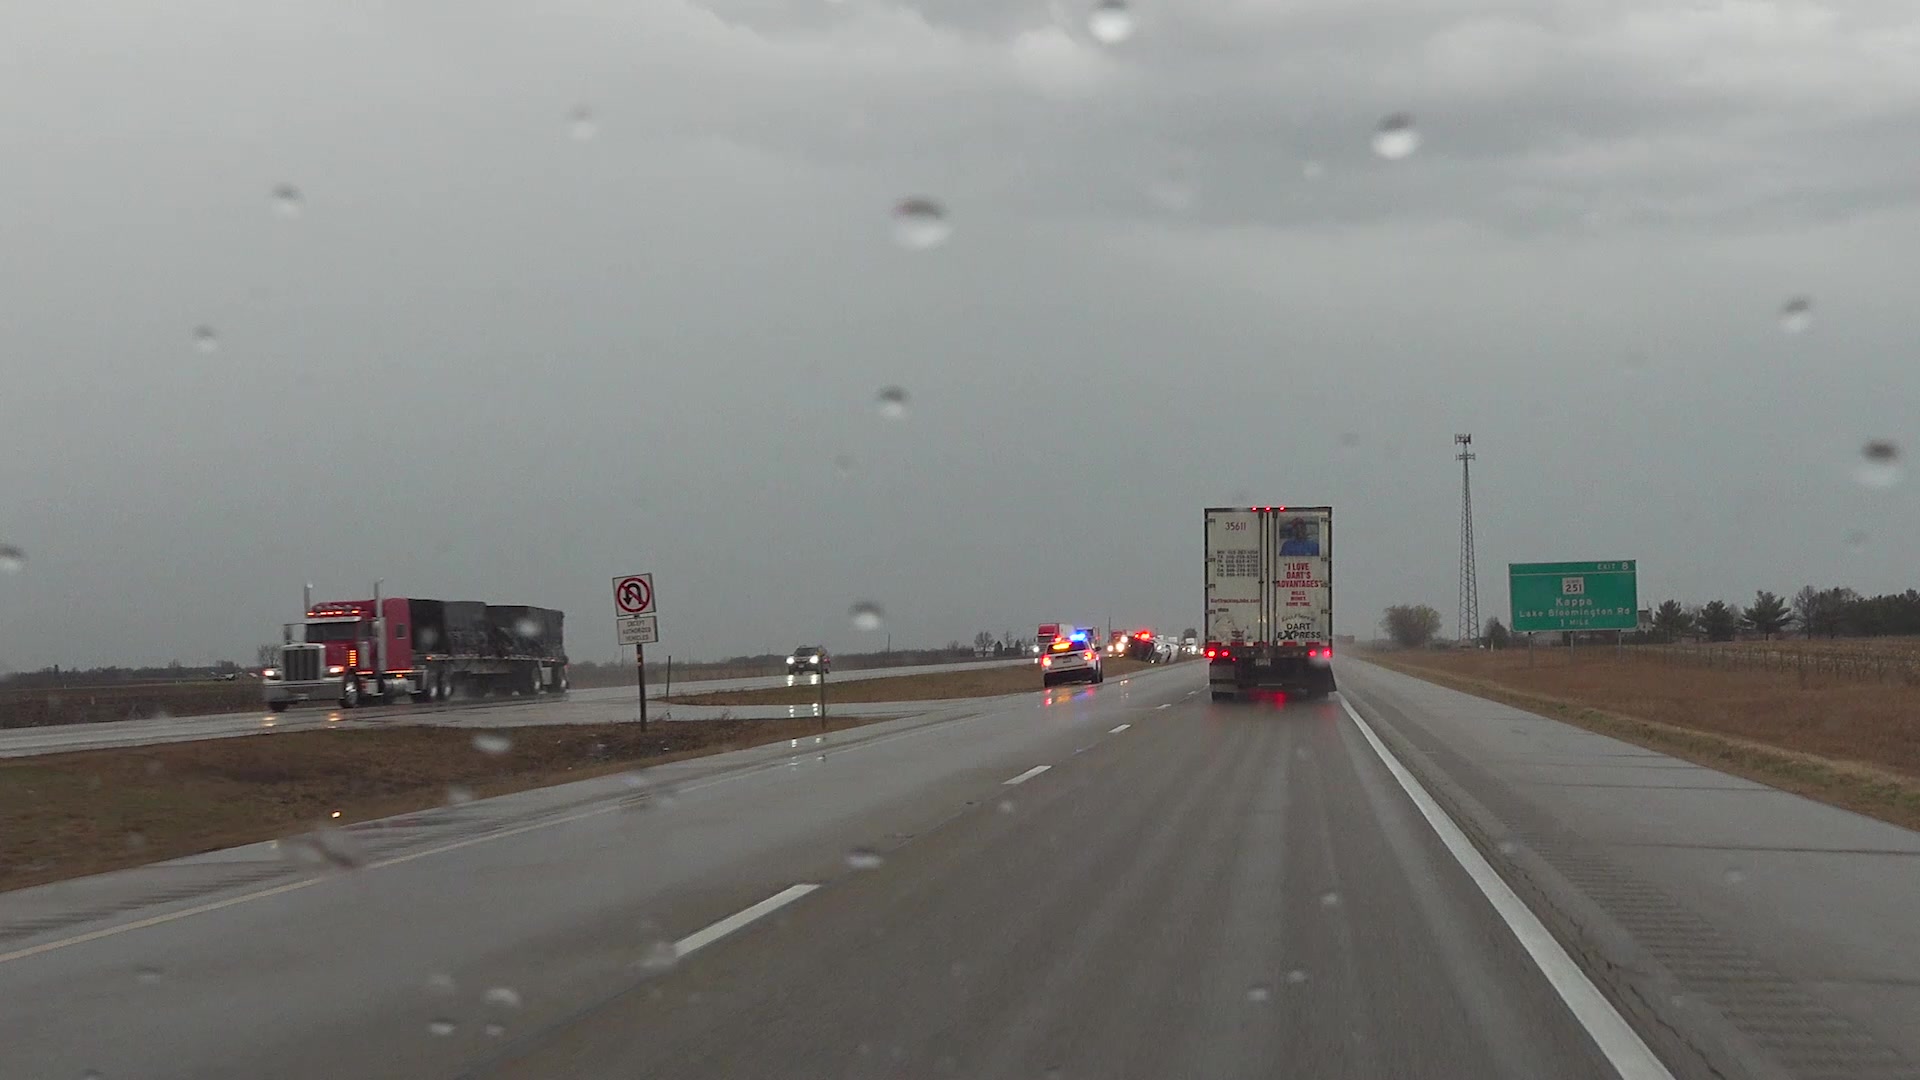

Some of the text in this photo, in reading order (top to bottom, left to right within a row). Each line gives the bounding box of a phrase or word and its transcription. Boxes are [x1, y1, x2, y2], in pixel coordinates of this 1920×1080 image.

[1225, 521, 1247, 531] 35611
[1292, 562, 1309, 571] LOVE
[1286, 571, 1311, 579] DART'S
[1564, 583, 1582, 593] 251
[1555, 598, 1593, 607] Kappa
[1519, 607, 1630, 618] Lake Bloomington Rd
[1569, 618, 1589, 626] MILE
[1277, 630, 1321, 640] EXPRESS
